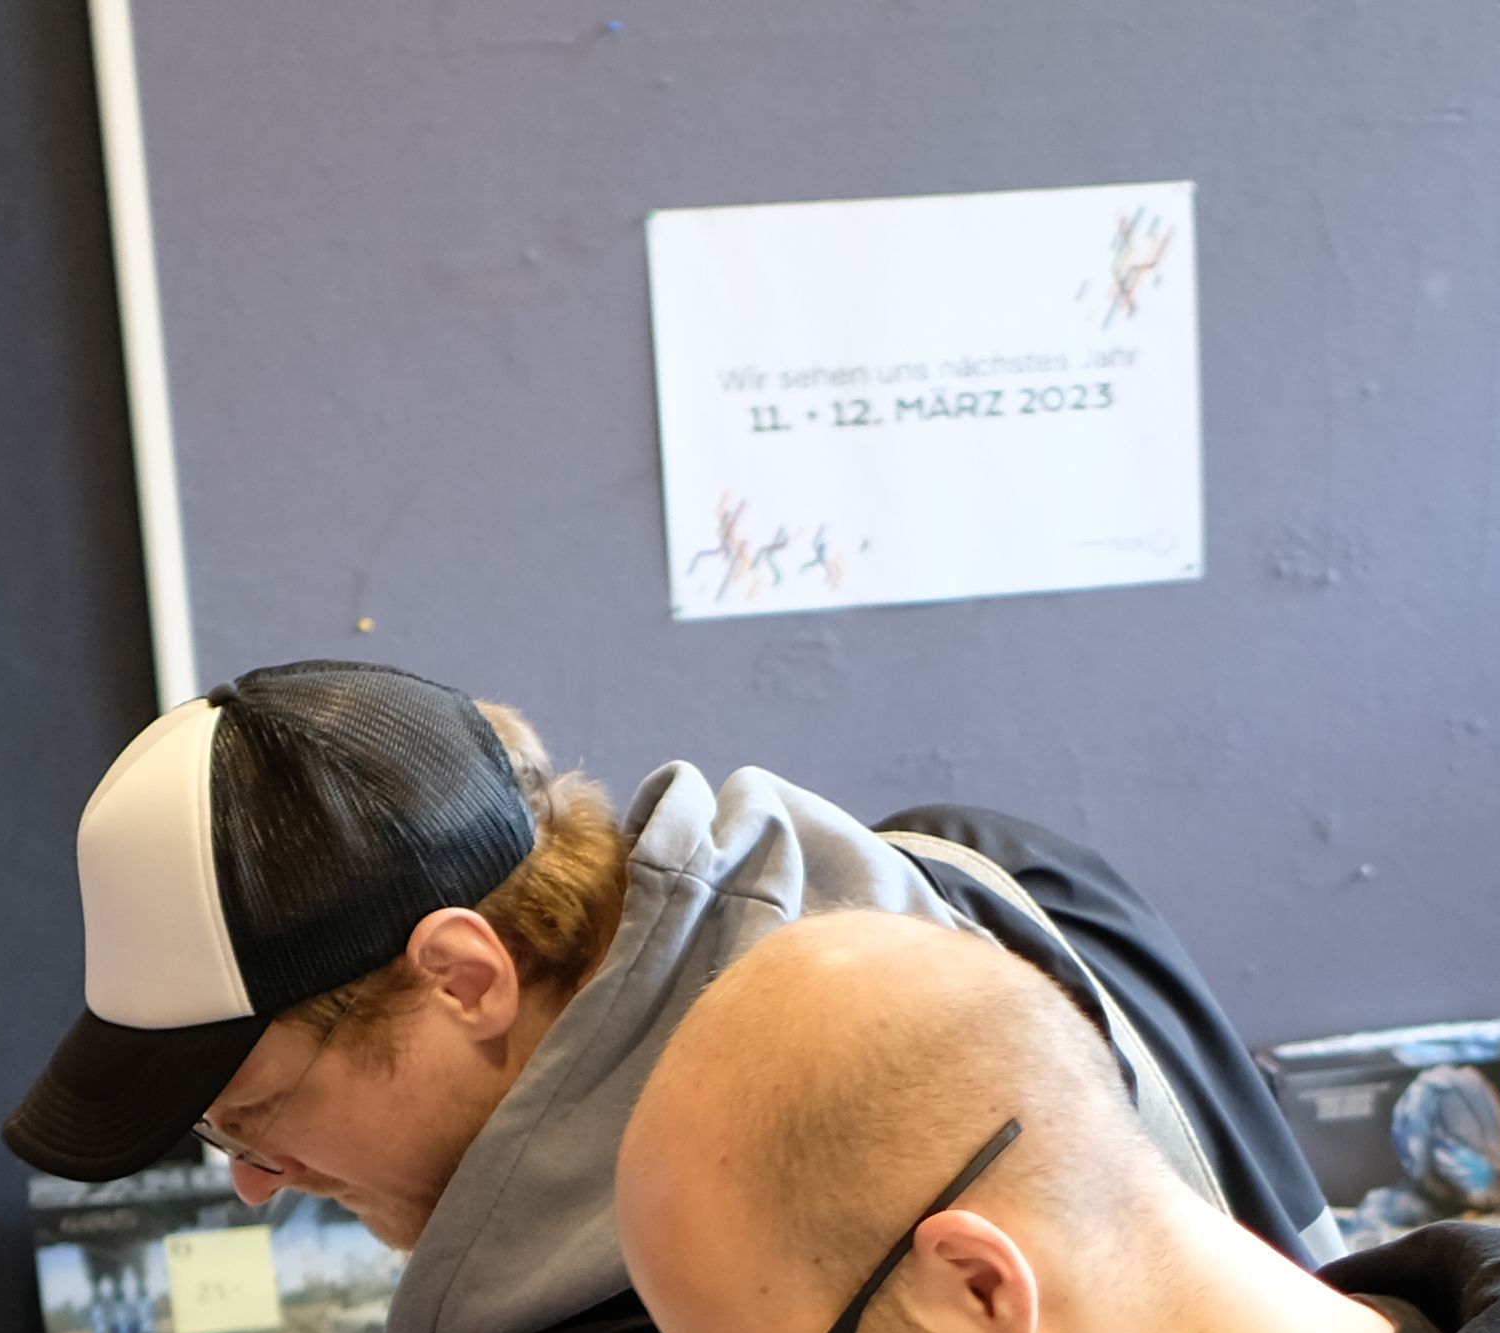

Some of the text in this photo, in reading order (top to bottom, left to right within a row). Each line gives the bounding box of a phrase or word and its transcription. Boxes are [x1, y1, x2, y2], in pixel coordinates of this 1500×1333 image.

[719, 365, 768, 394] Wir
[779, 362, 869, 390] sehen
[877, 361, 930, 384] uns
[749, 381, 1115, 434] 11. 12. MÄRZ 2023
